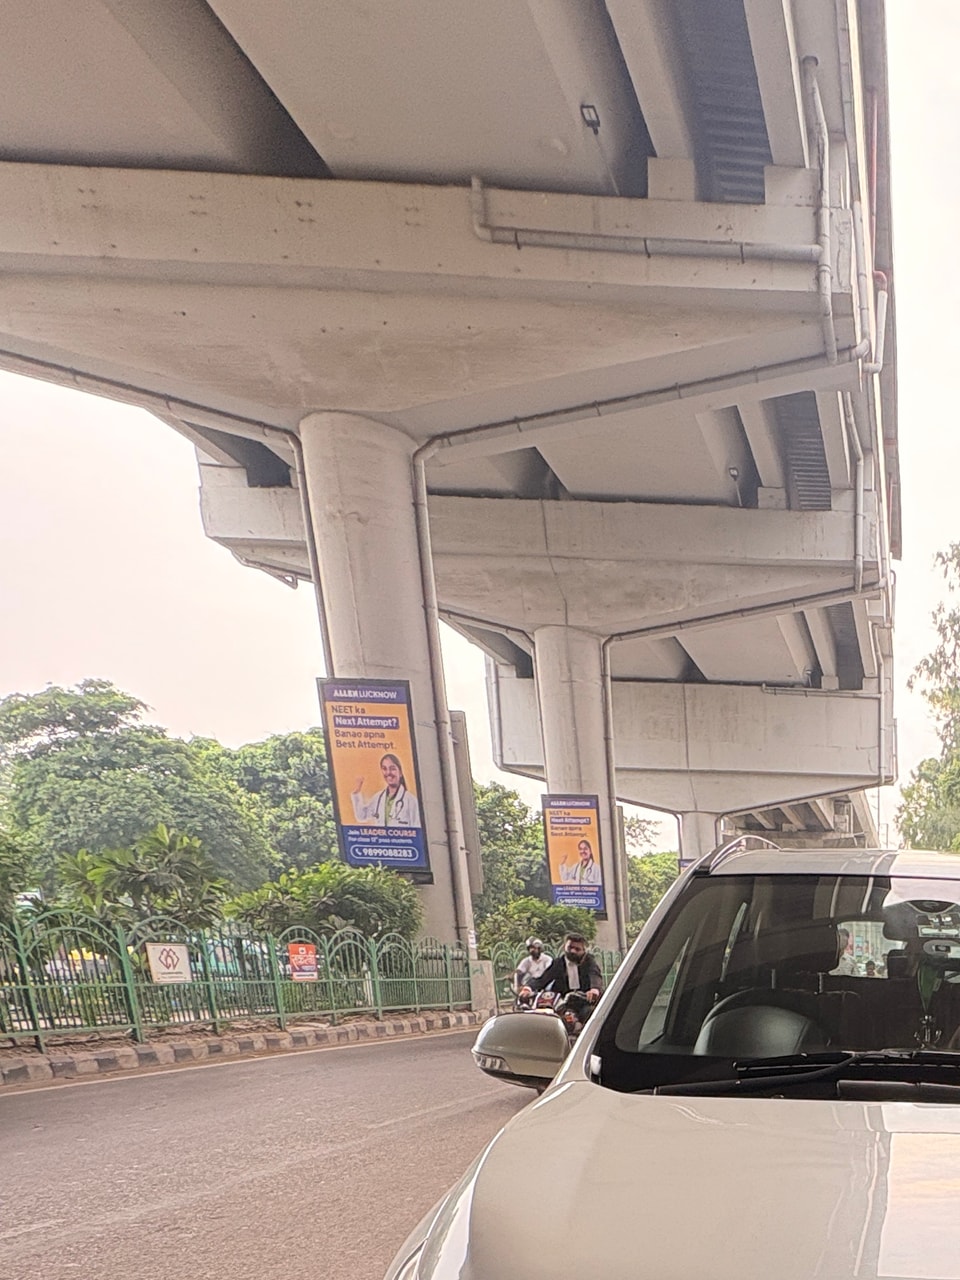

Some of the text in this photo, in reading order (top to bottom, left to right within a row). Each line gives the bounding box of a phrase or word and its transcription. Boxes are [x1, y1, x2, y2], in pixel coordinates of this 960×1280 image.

[333, 689, 397, 699] ALLEN LUCKNOW
[331, 705, 366, 714] NEET ka
[335, 716, 397, 728] Next Attempt?
[334, 729, 385, 740] Banao apna
[336, 740, 356, 748] Best
